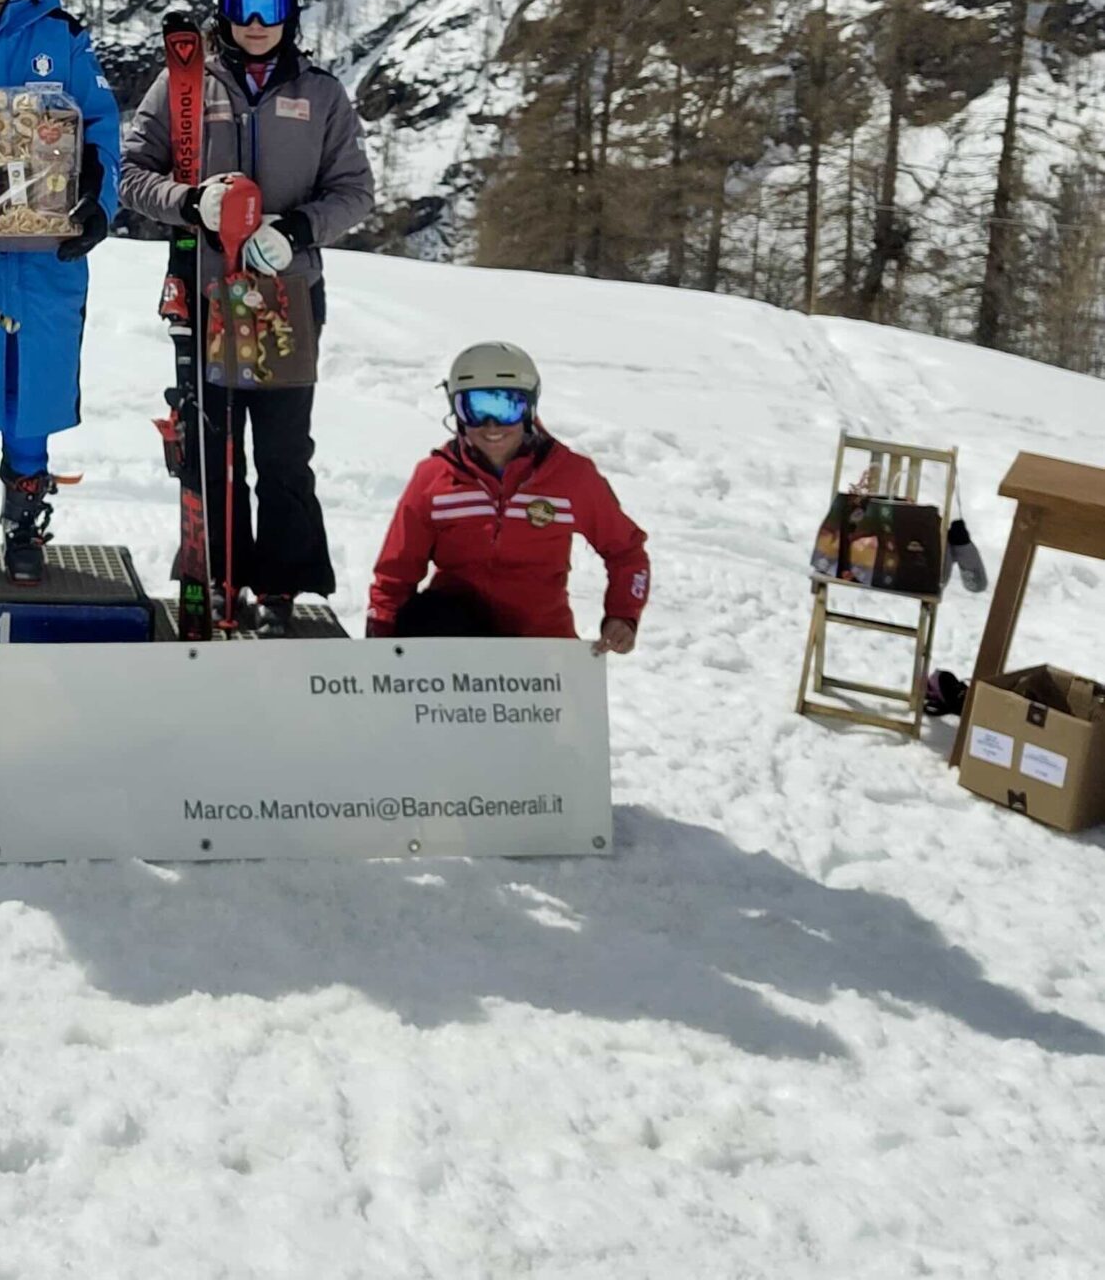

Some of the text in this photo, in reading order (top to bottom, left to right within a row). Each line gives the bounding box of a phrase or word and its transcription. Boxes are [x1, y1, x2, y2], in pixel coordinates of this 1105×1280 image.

[180, 85, 192, 179] ROSSIGNOL
[310, 673, 562, 695] Dott. Marco Mantovani
[415, 703, 562, 724] Private Banker
[184, 795, 563, 822] Marco.Mantovani@BancaGenerali.it
